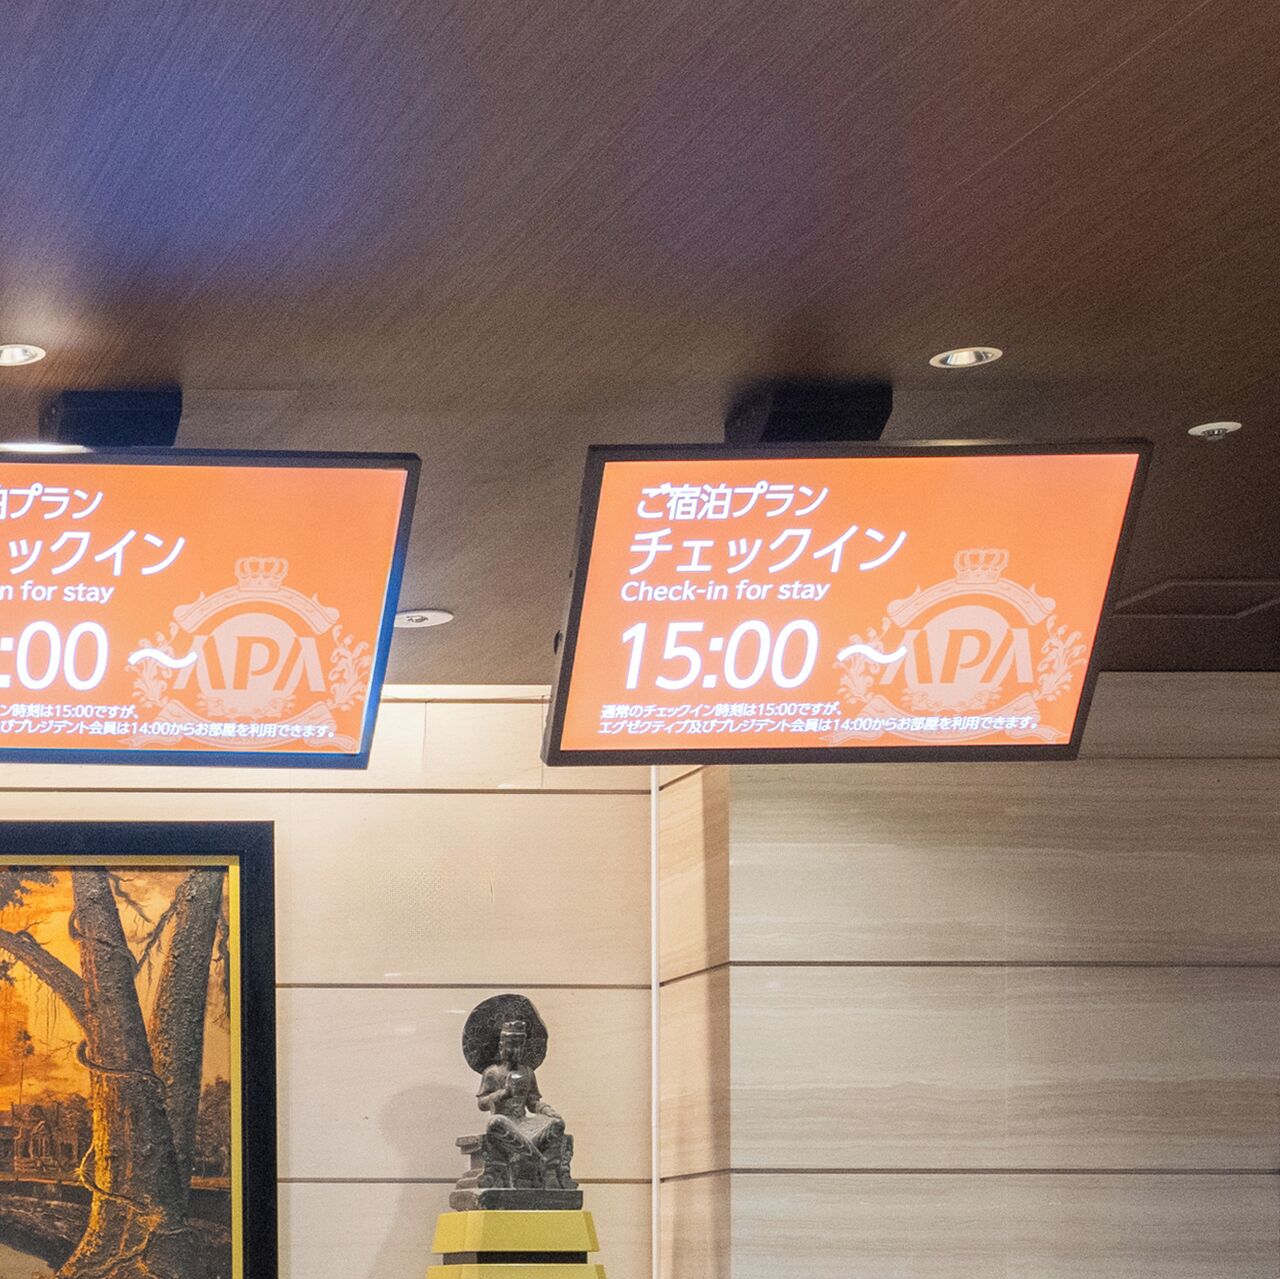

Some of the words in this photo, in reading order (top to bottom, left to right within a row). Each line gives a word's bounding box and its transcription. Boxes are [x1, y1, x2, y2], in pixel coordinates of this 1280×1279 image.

[637, 481, 829, 520] ご宿泊プラン
[629, 525, 906, 574] チェックイン
[20, 579, 57, 602] for
[64, 583, 114, 605] stay
[621, 580, 728, 602] Check-in
[736, 580, 772, 601] for
[778, 581, 830, 602] stay
[620, 619, 820, 690] 15:00
